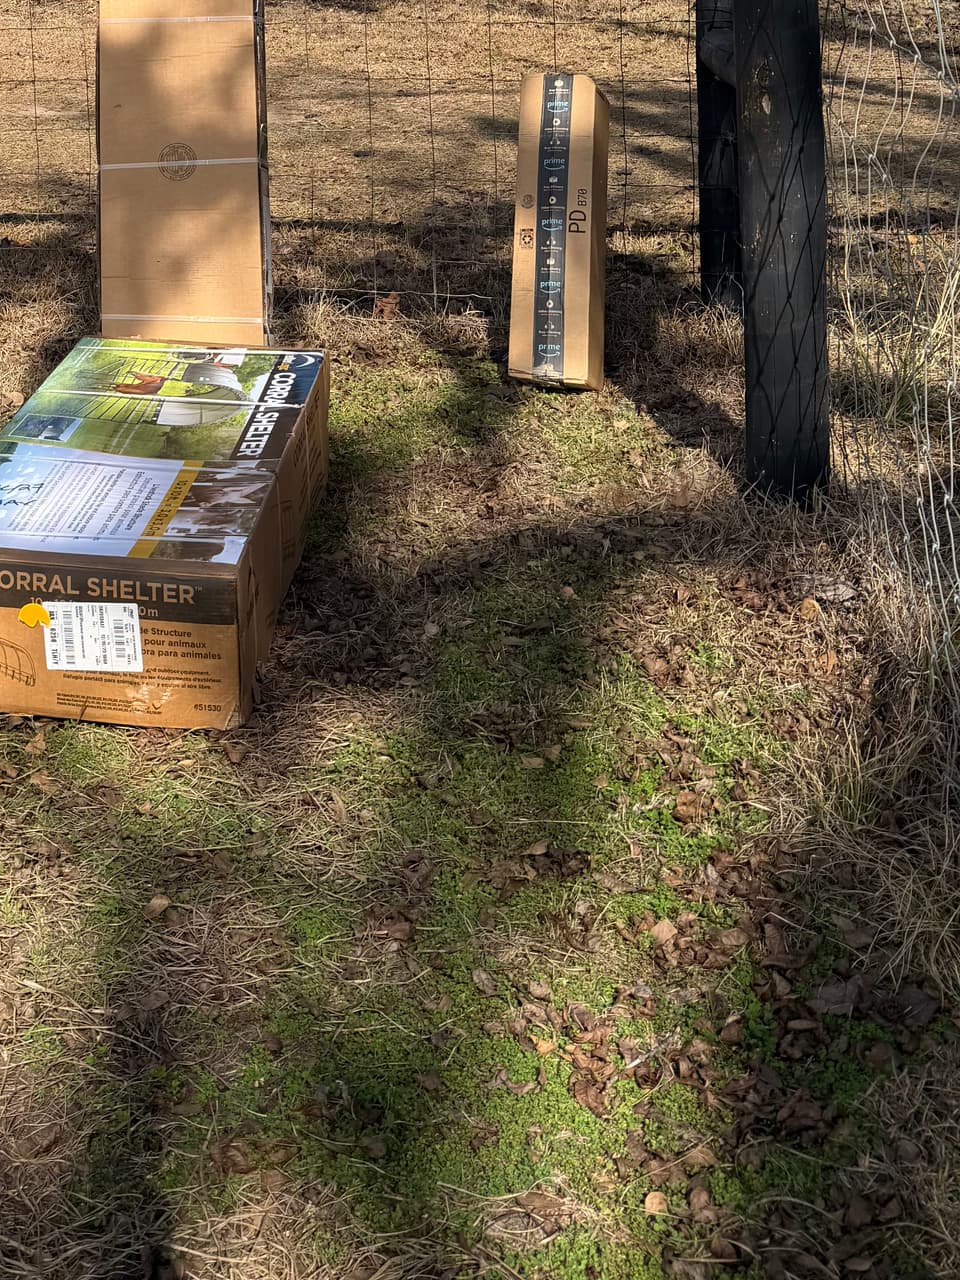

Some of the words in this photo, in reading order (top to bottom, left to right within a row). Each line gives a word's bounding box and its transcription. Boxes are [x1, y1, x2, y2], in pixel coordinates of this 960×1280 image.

[568, 210, 587, 233] PD
[236, 411, 280, 458] SHELTER
[151, 627, 192, 638] Structure
[144, 638, 166, 647] pour
[168, 640, 207, 649] animaux
[180, 651, 222, 660] animales
